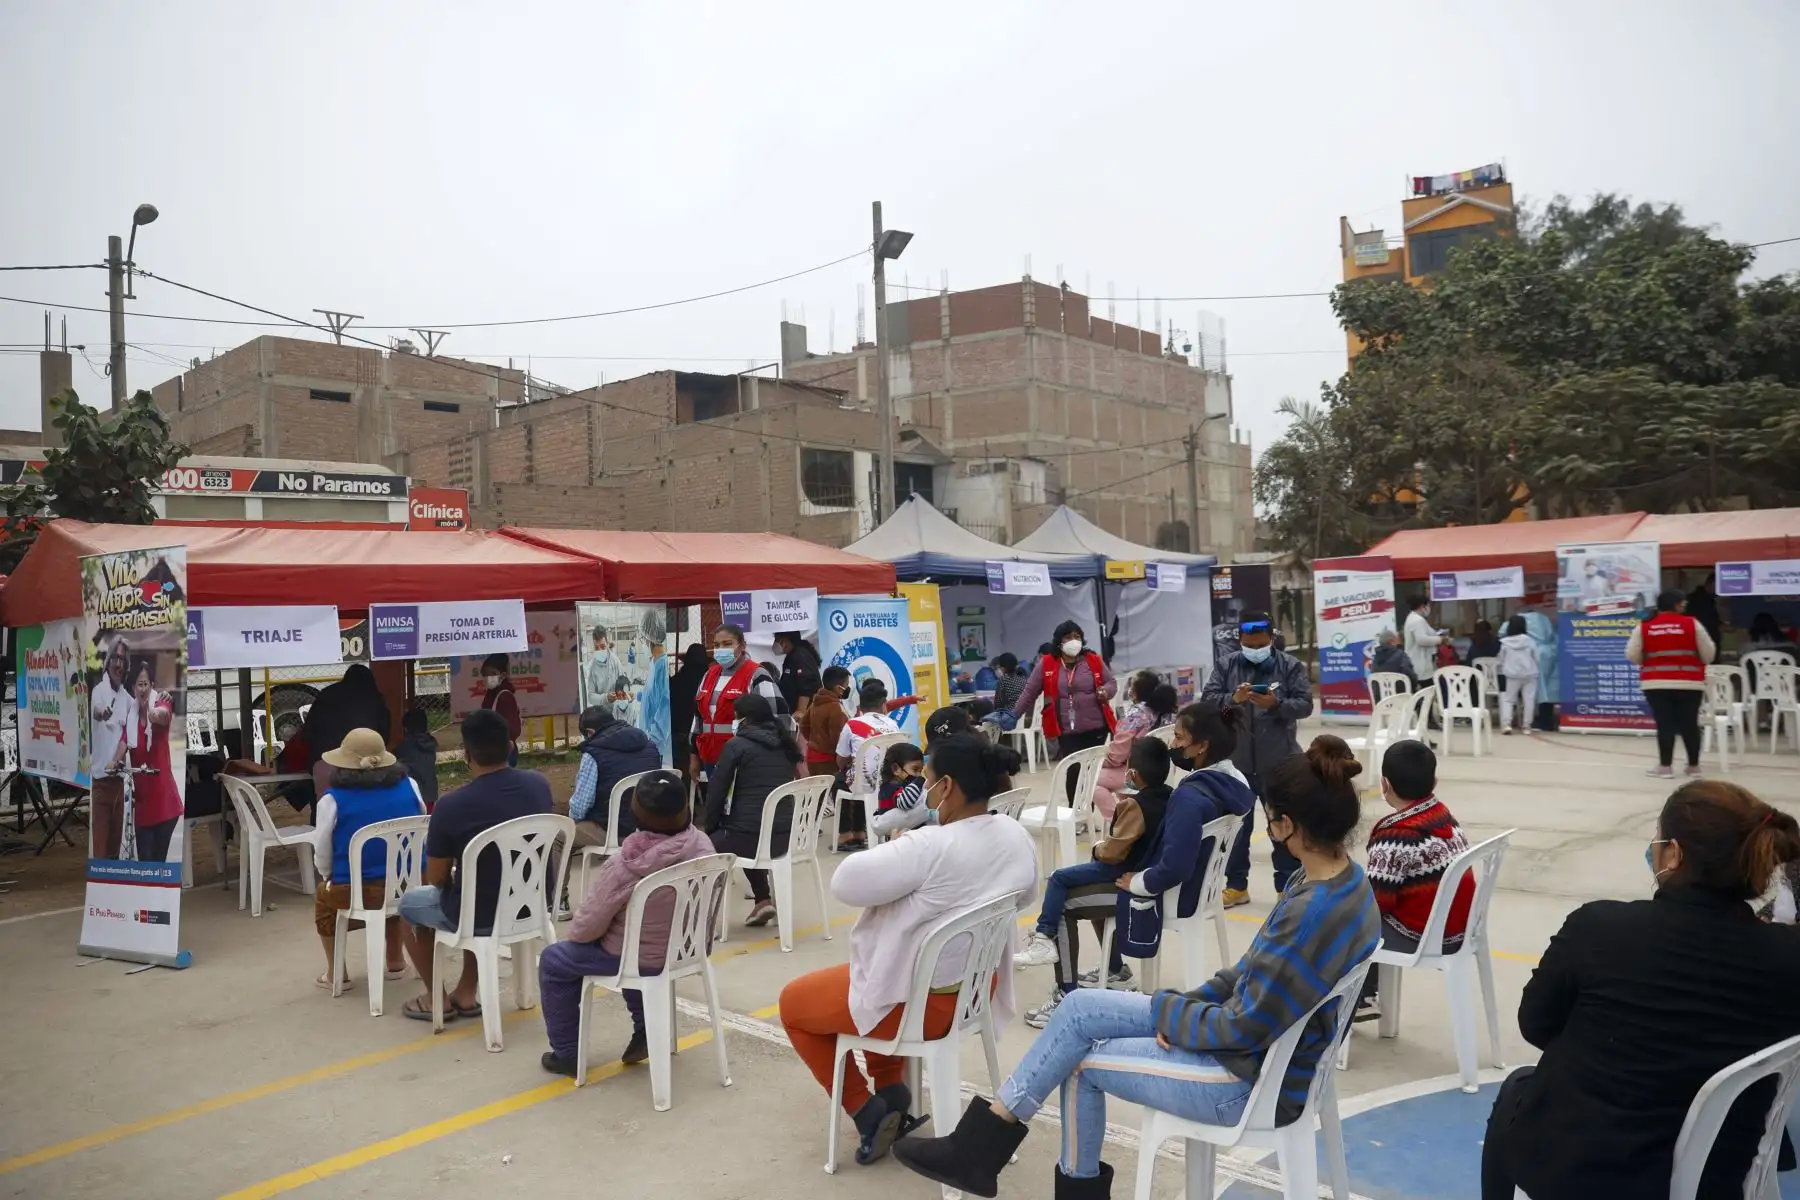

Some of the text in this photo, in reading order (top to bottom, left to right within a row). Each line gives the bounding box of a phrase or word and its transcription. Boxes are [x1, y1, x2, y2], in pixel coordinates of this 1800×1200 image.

[204, 478, 229, 487] 6323
[278, 473, 391, 495] No Paramos
[413, 504, 463, 519] Clínica
[99, 585, 144, 613] MEJOR
[724, 601, 749, 611] MINSA
[766, 600, 801, 611] TAMIZAJE
[1341, 601, 1372, 617] PERÚ
[376, 616, 415, 628] MINSA
[450, 616, 495, 628] TOMA DE
[762, 611, 810, 623] DE GLUCOSA
[853, 618, 898, 628] DIABETES
[241, 629, 303, 644] TRIAJE
[425, 630, 470, 643] PRESIÓN
[472, 628, 518, 640] ARTERIAL
